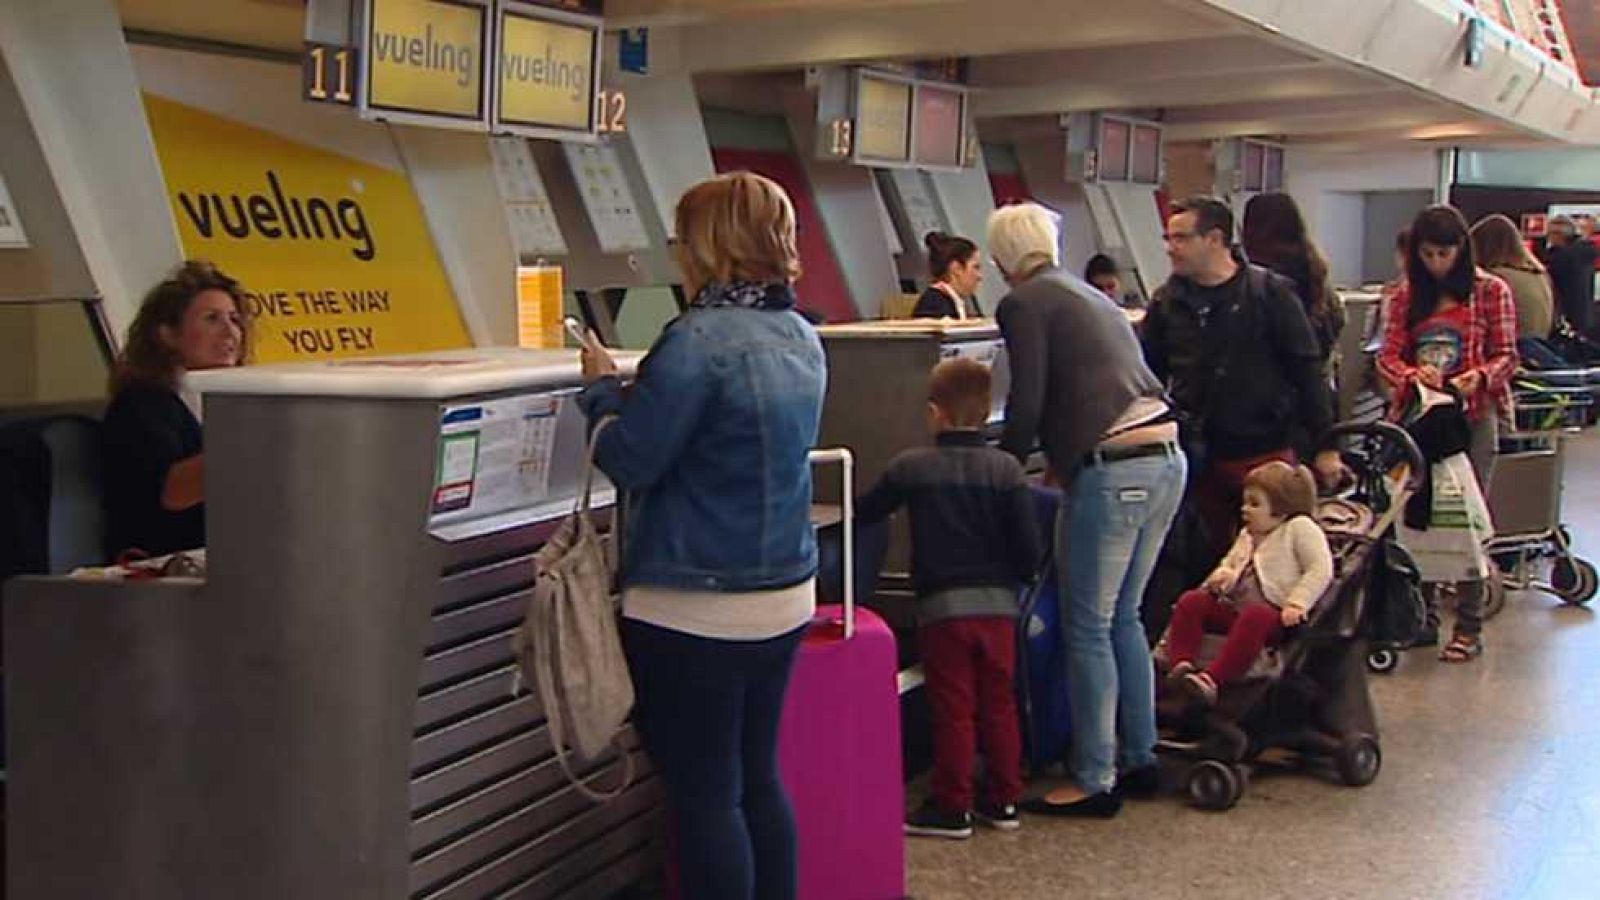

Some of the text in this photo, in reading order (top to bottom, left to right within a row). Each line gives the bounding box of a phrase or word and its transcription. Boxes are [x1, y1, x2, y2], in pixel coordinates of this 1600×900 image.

[310, 48, 350, 101] 11
[375, 24, 474, 88] vueling
[502, 43, 586, 102] vueling
[598, 91, 625, 131] 12
[178, 170, 375, 261] vueling
[242, 290, 391, 318] OVE THE WAY
[284, 327, 375, 354] YOU FLY
